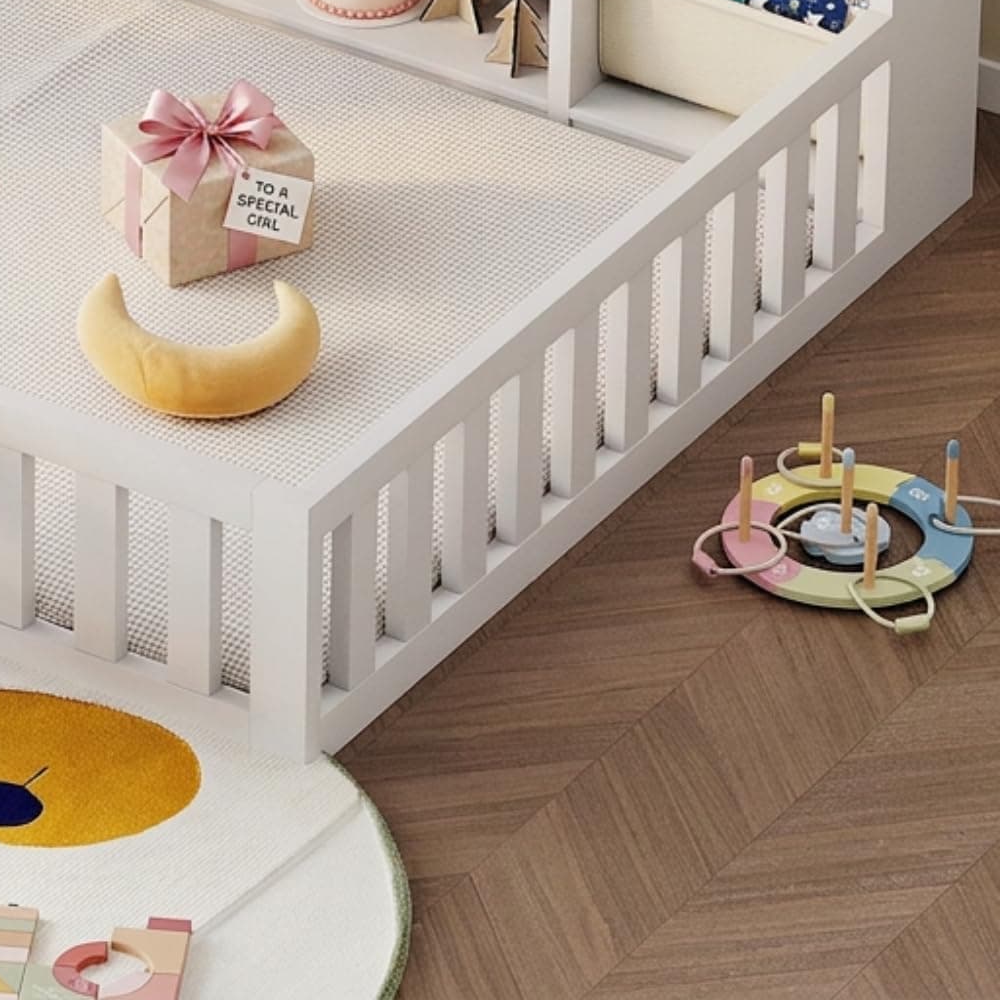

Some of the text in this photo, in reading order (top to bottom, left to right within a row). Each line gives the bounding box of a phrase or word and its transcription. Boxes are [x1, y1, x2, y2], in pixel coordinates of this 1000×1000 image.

[255, 180, 289, 199] TO A
[236, 193, 299, 220] SPECIAL
